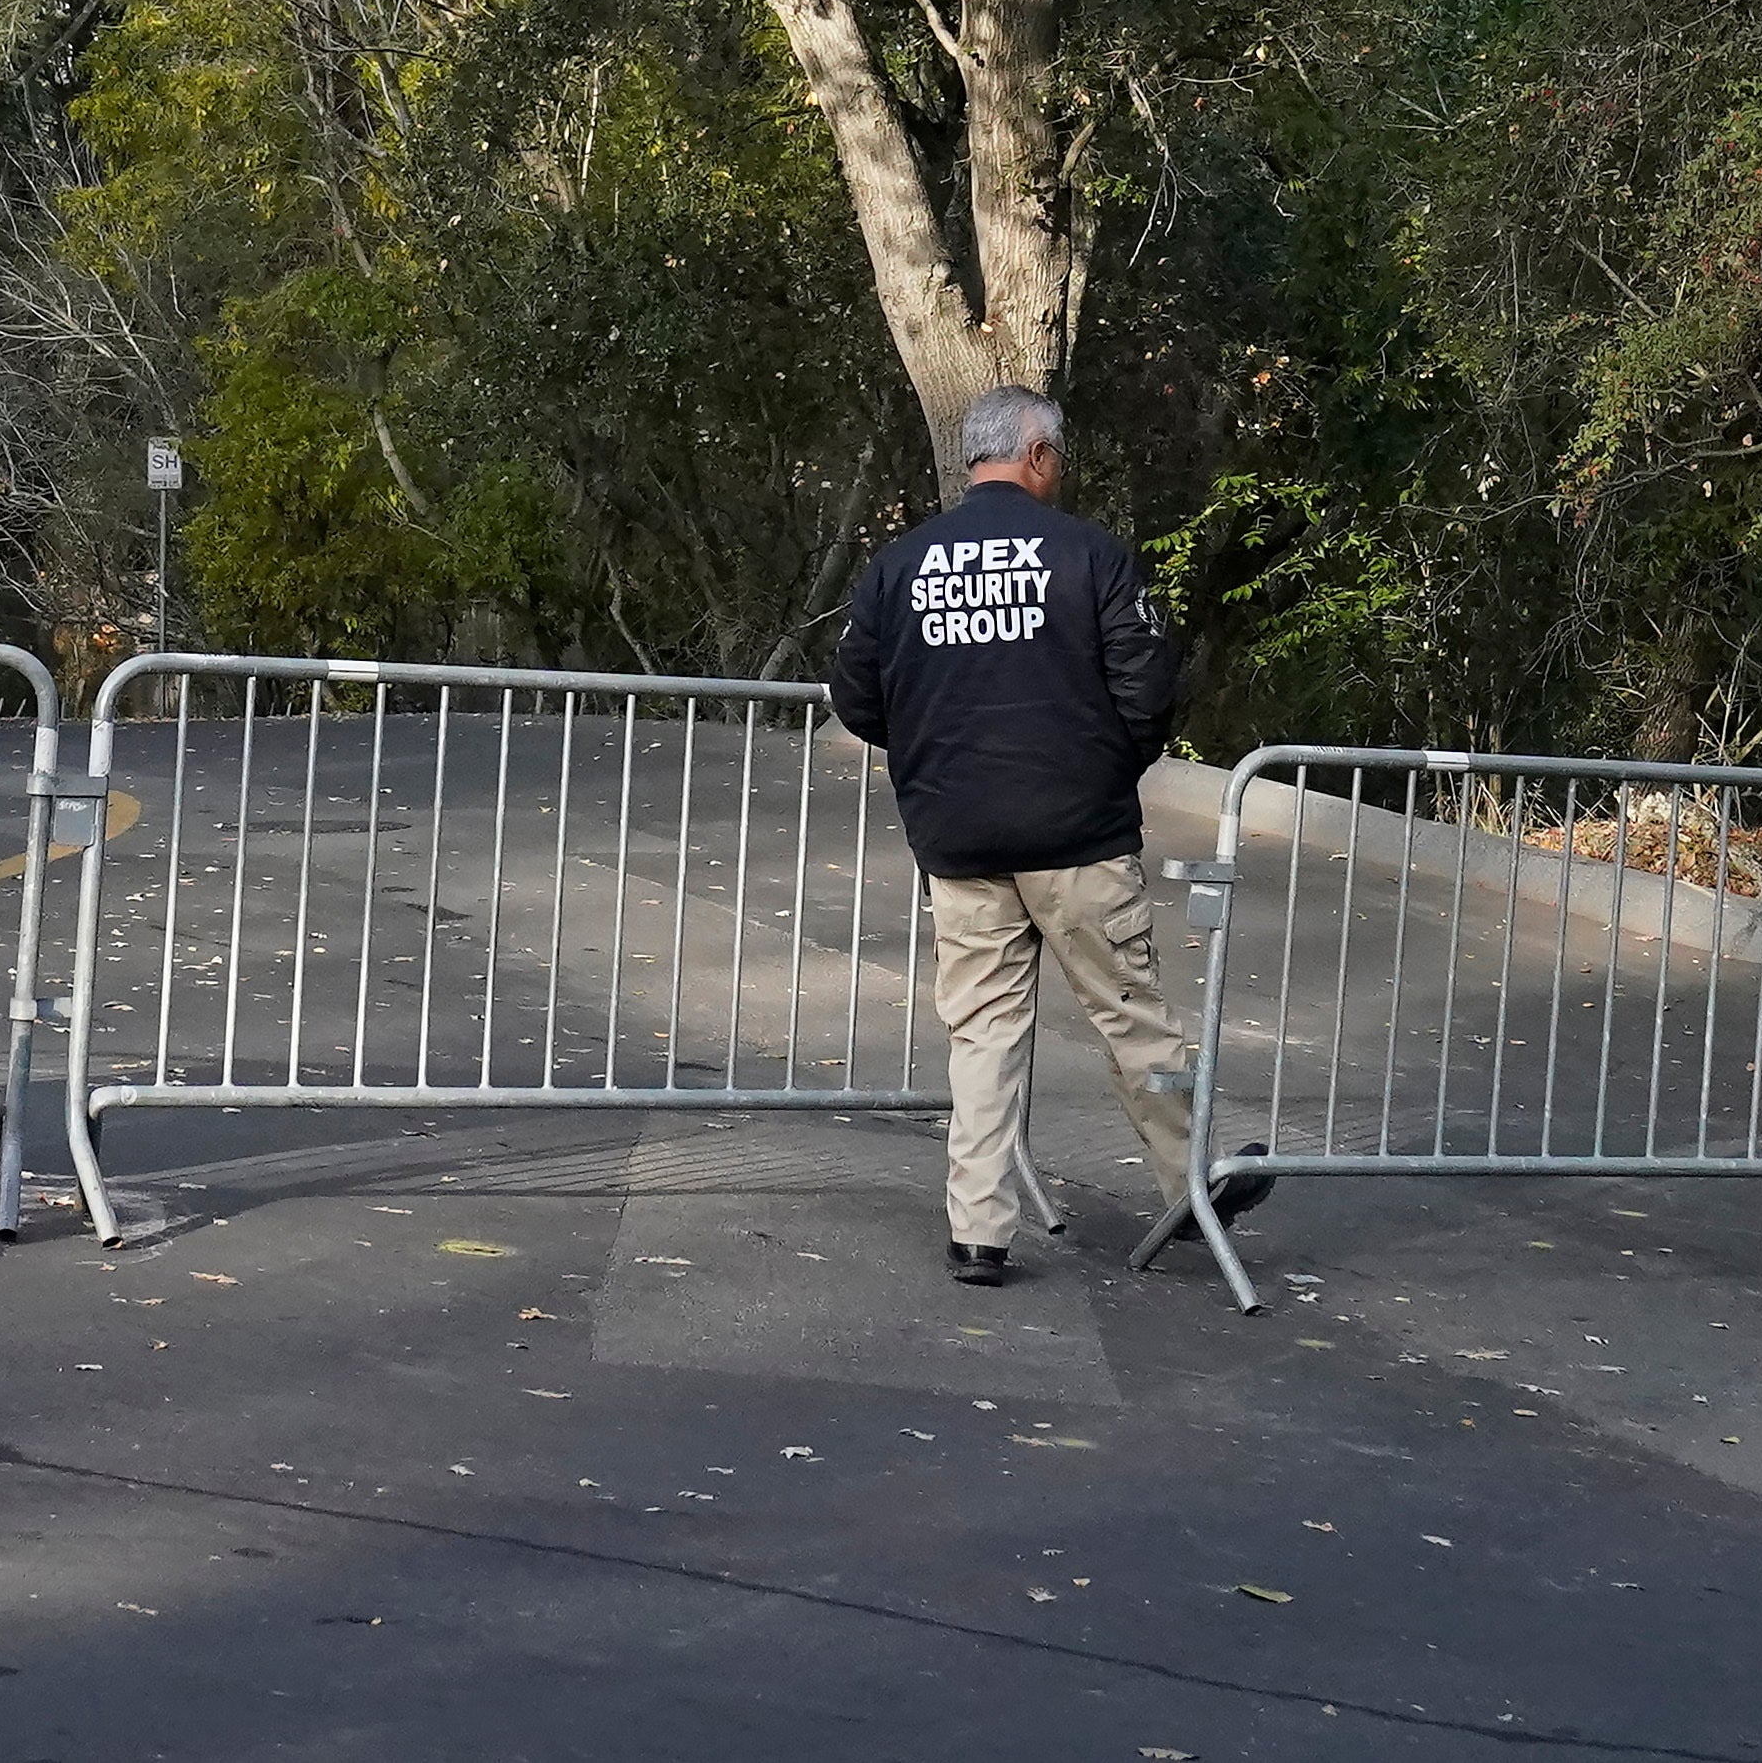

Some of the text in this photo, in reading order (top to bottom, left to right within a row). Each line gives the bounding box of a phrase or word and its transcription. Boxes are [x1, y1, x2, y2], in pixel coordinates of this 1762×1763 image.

[152, 454, 177, 469] SH
[919, 537, 1044, 575] APEX
[910, 570, 1052, 612] SECURITY
[922, 606, 1045, 647] GROUP
